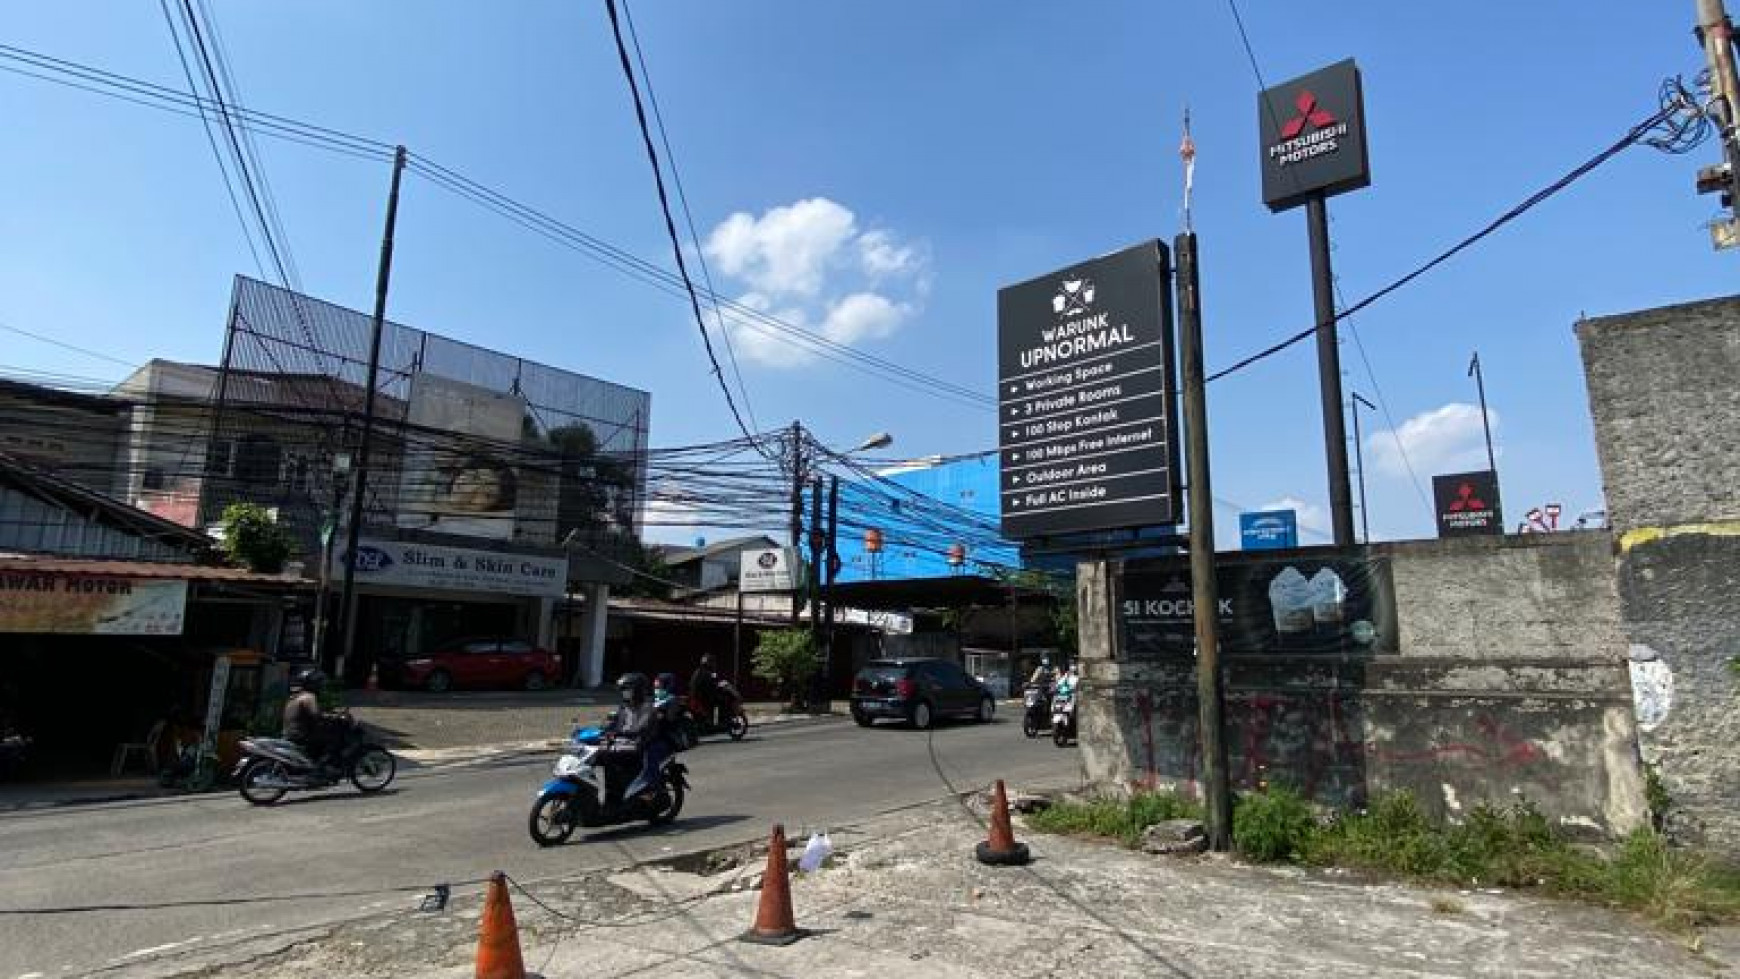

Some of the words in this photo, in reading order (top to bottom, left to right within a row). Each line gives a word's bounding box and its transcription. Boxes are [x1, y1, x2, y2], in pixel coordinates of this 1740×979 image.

[1270, 122, 1347, 157] MITSUBISHI
[1280, 140, 1338, 166] MOTORS
[1042, 312, 1109, 343] WARUNK
[1020, 323, 1135, 368] UPNORMAL
[1025, 373, 1073, 390] Working
[1075, 362, 1113, 381] Space
[1024, 402, 1032, 416] 3
[1034, 395, 1076, 412] Private
[1078, 385, 1122, 402] Rooms
[1025, 423, 1045, 438] 100
[1046, 420, 1072, 434] Stop
[1075, 408, 1118, 427] Kontak
[1025, 447, 1044, 461] 100
[1046, 443, 1077, 456] Mbps
[1078, 438, 1104, 451] Free
[1105, 427, 1152, 446] Internet
[1025, 467, 1075, 484] Outdoor
[1076, 462, 1107, 477] Area
[1025, 493, 1047, 507] Full
[1048, 488, 1066, 504] AC
[1068, 484, 1107, 501] Inside
[402, 549, 445, 569] Slim
[453, 555, 468, 570] &
[476, 556, 513, 575] Skin
[520, 560, 556, 578] Care
[1123, 599, 1140, 615] SI
